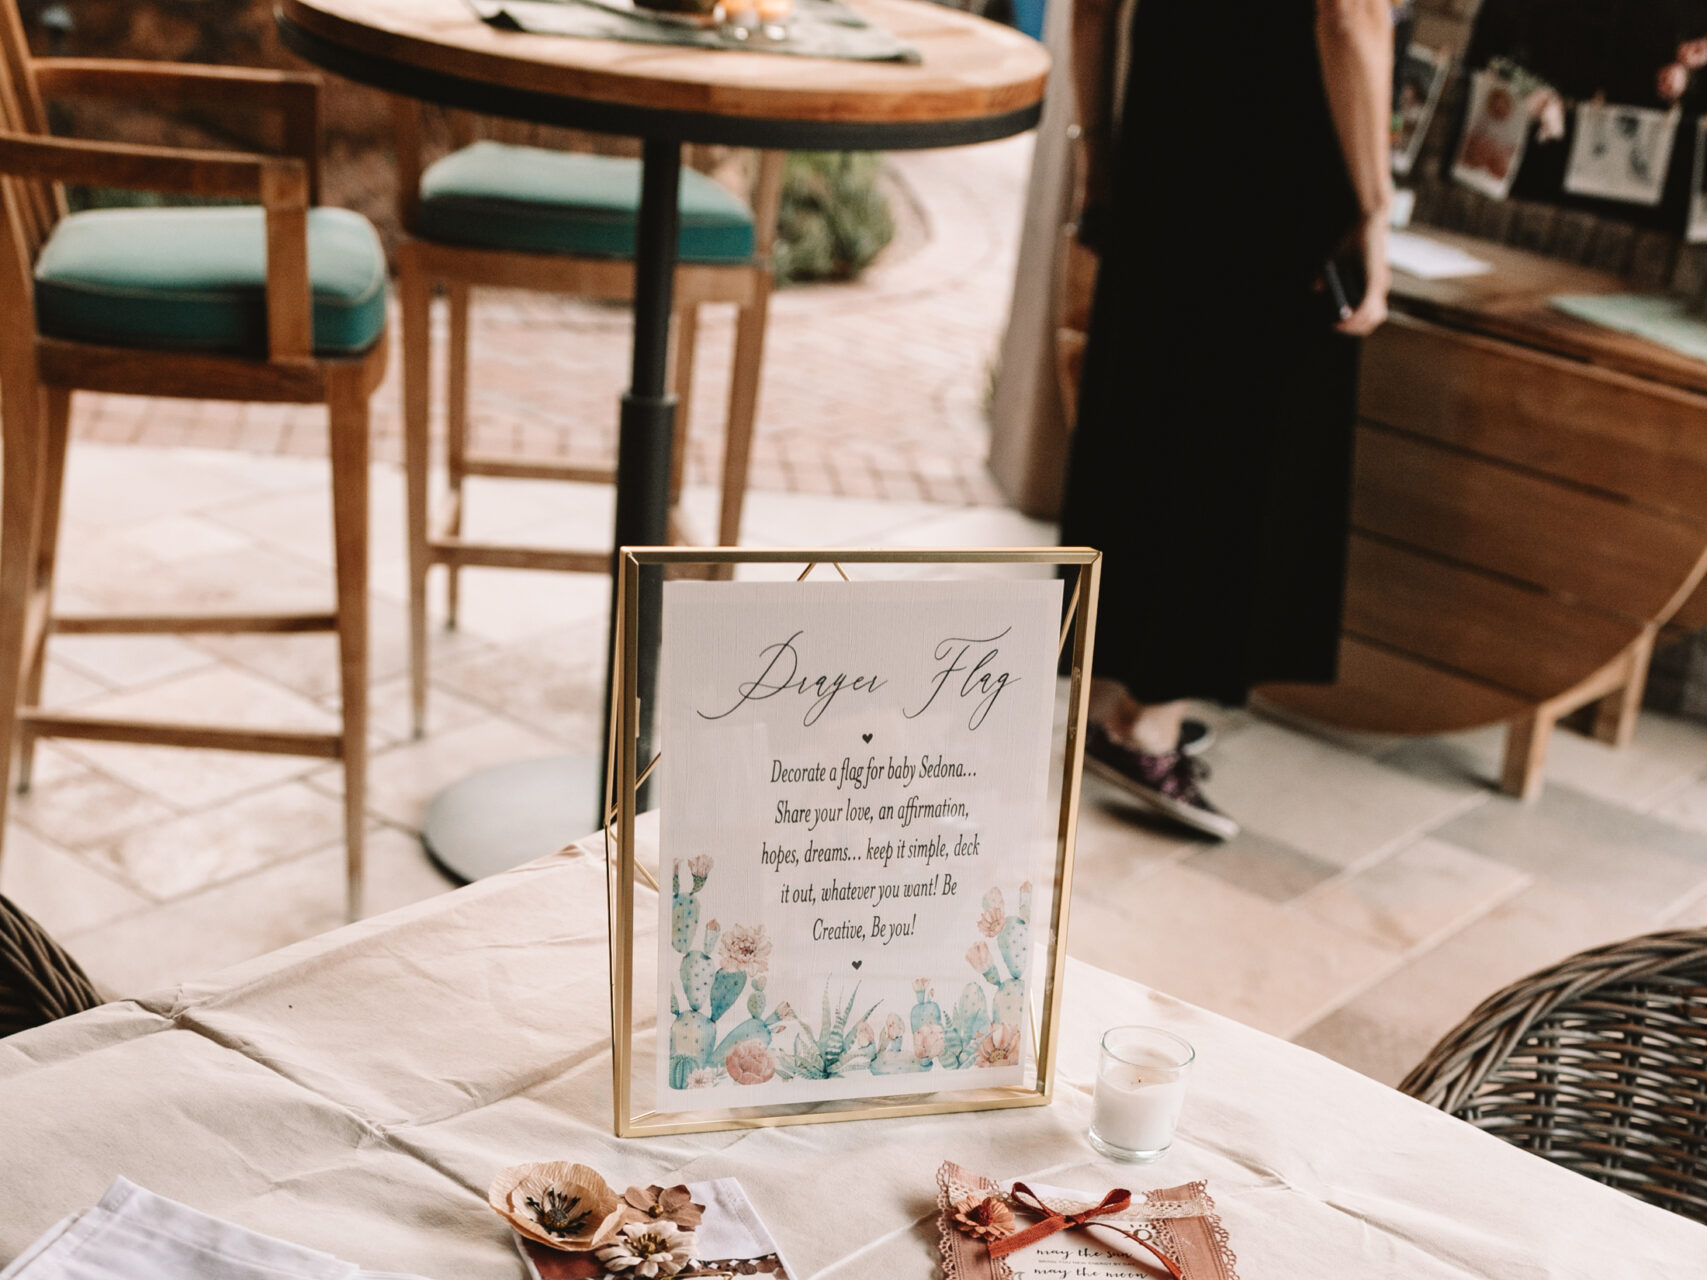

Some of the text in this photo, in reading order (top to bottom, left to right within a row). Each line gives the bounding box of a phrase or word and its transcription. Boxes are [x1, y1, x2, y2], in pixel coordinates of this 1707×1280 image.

[697, 626, 1022, 731] Prayer Flag
[770, 754, 977, 790] Decorate a flag for baby Sedona...
[774, 795, 969, 831] Share your love, an affirmation,
[761, 833, 980, 872] hopes, dreams... keep it simple, deck
[780, 873, 957, 907] it out, whatever you want! Be
[812, 913, 917, 945] Creative, Be you!
[1036, 1247, 1133, 1260] may the sun
[1034, 1267, 1149, 1280] may the moon
